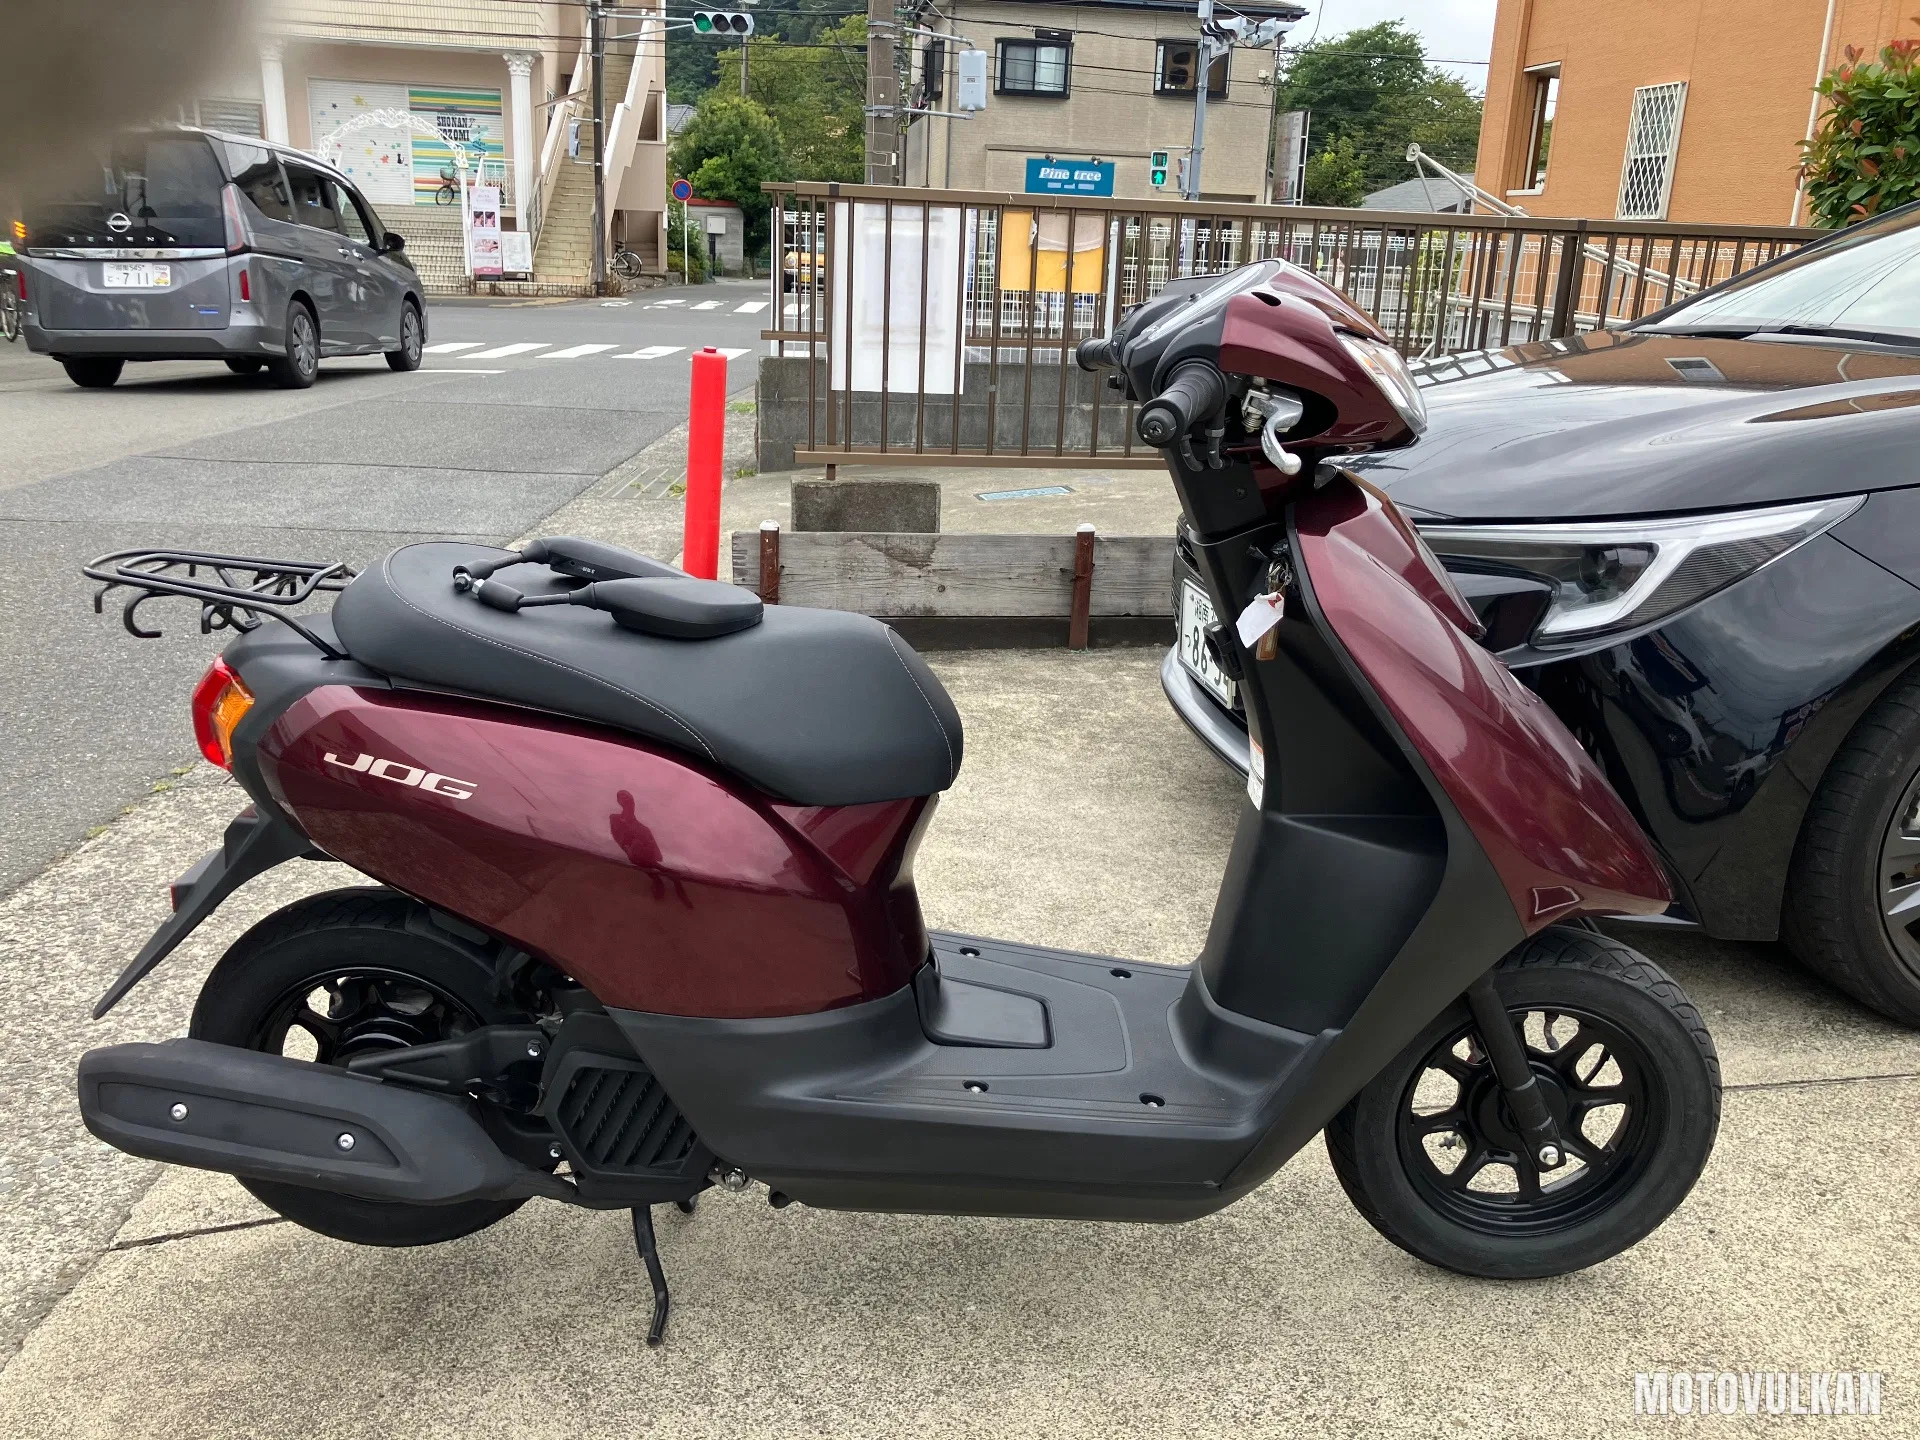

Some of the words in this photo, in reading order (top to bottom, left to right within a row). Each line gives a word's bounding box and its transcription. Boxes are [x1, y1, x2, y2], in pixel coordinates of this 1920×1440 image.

[437, 116, 468, 128] SHONAN
[1039, 167, 1070, 180] Pine
[1074, 170, 1102, 181] tree
[323, 752, 478, 800] JOG
